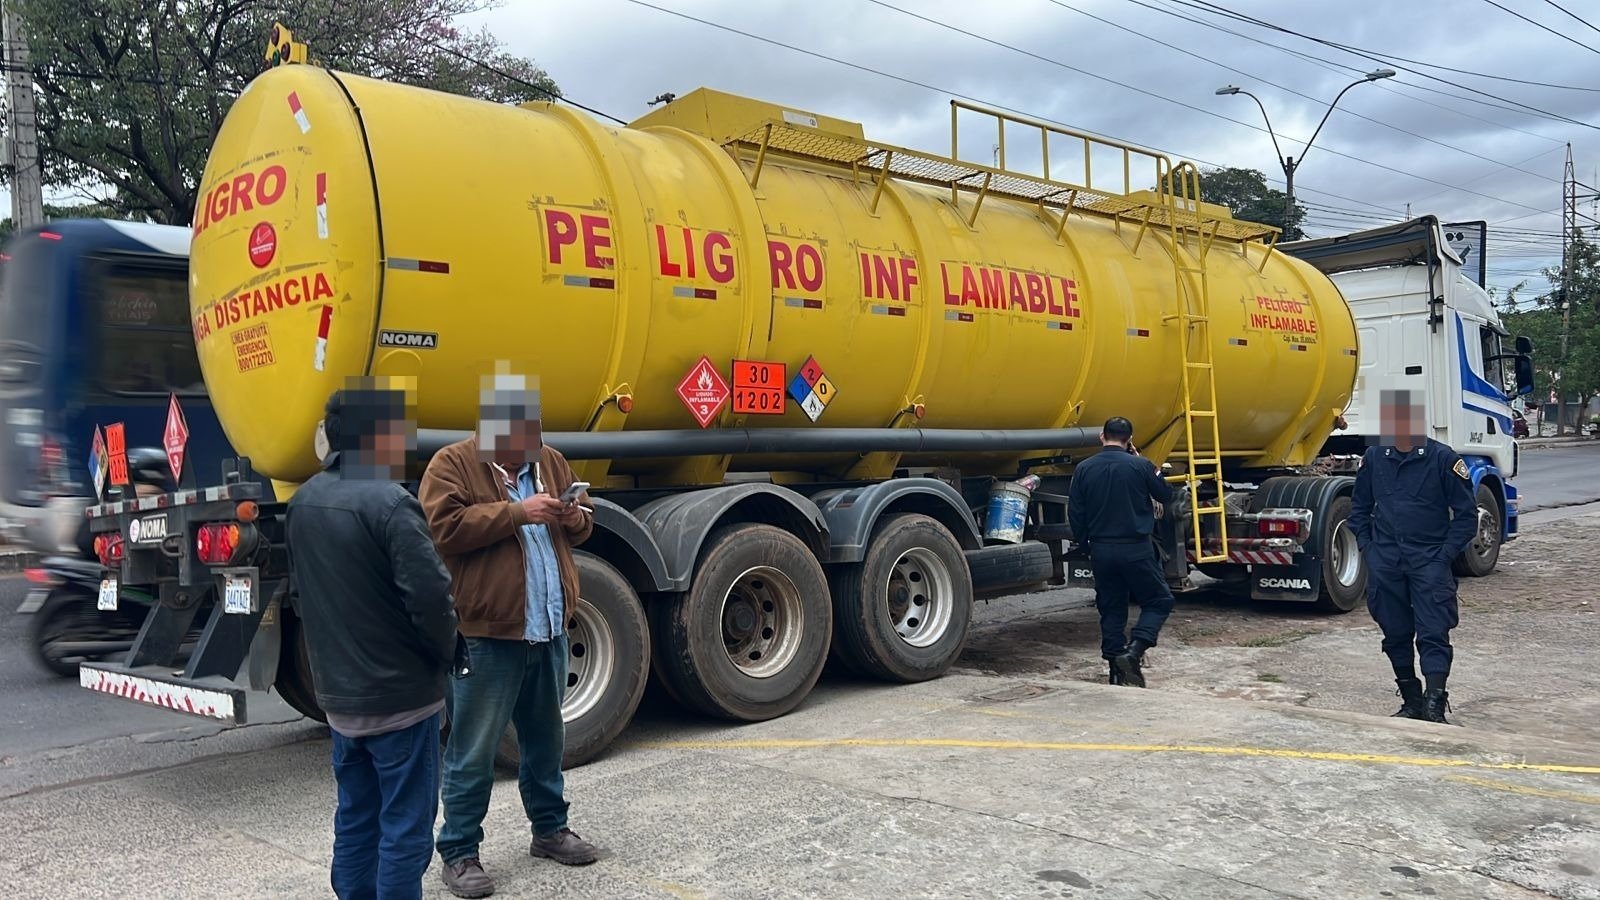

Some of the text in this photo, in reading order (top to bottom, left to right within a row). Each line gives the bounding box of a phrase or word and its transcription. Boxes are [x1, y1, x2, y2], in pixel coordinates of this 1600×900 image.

[545, 209, 1080, 318] PE LIG RO INF LAMABLE
[214, 272, 334, 330] DISTANCIA
[1256, 296, 1302, 314] PELIGRO
[1250, 313, 1317, 333] INFLAMABLE
[236, 338, 268, 357] EMERGENCIA
[381, 332, 434, 347] NOMA
[750, 365, 769, 384] 30
[807, 368, 815, 381] 2
[819, 383, 827, 395] 0
[700, 404, 709, 415] 3
[736, 391, 781, 410] 1202
[173, 454, 179, 468] 3
[140, 518, 167, 539] NOMA
[1259, 578, 1311, 590] SCANIA
